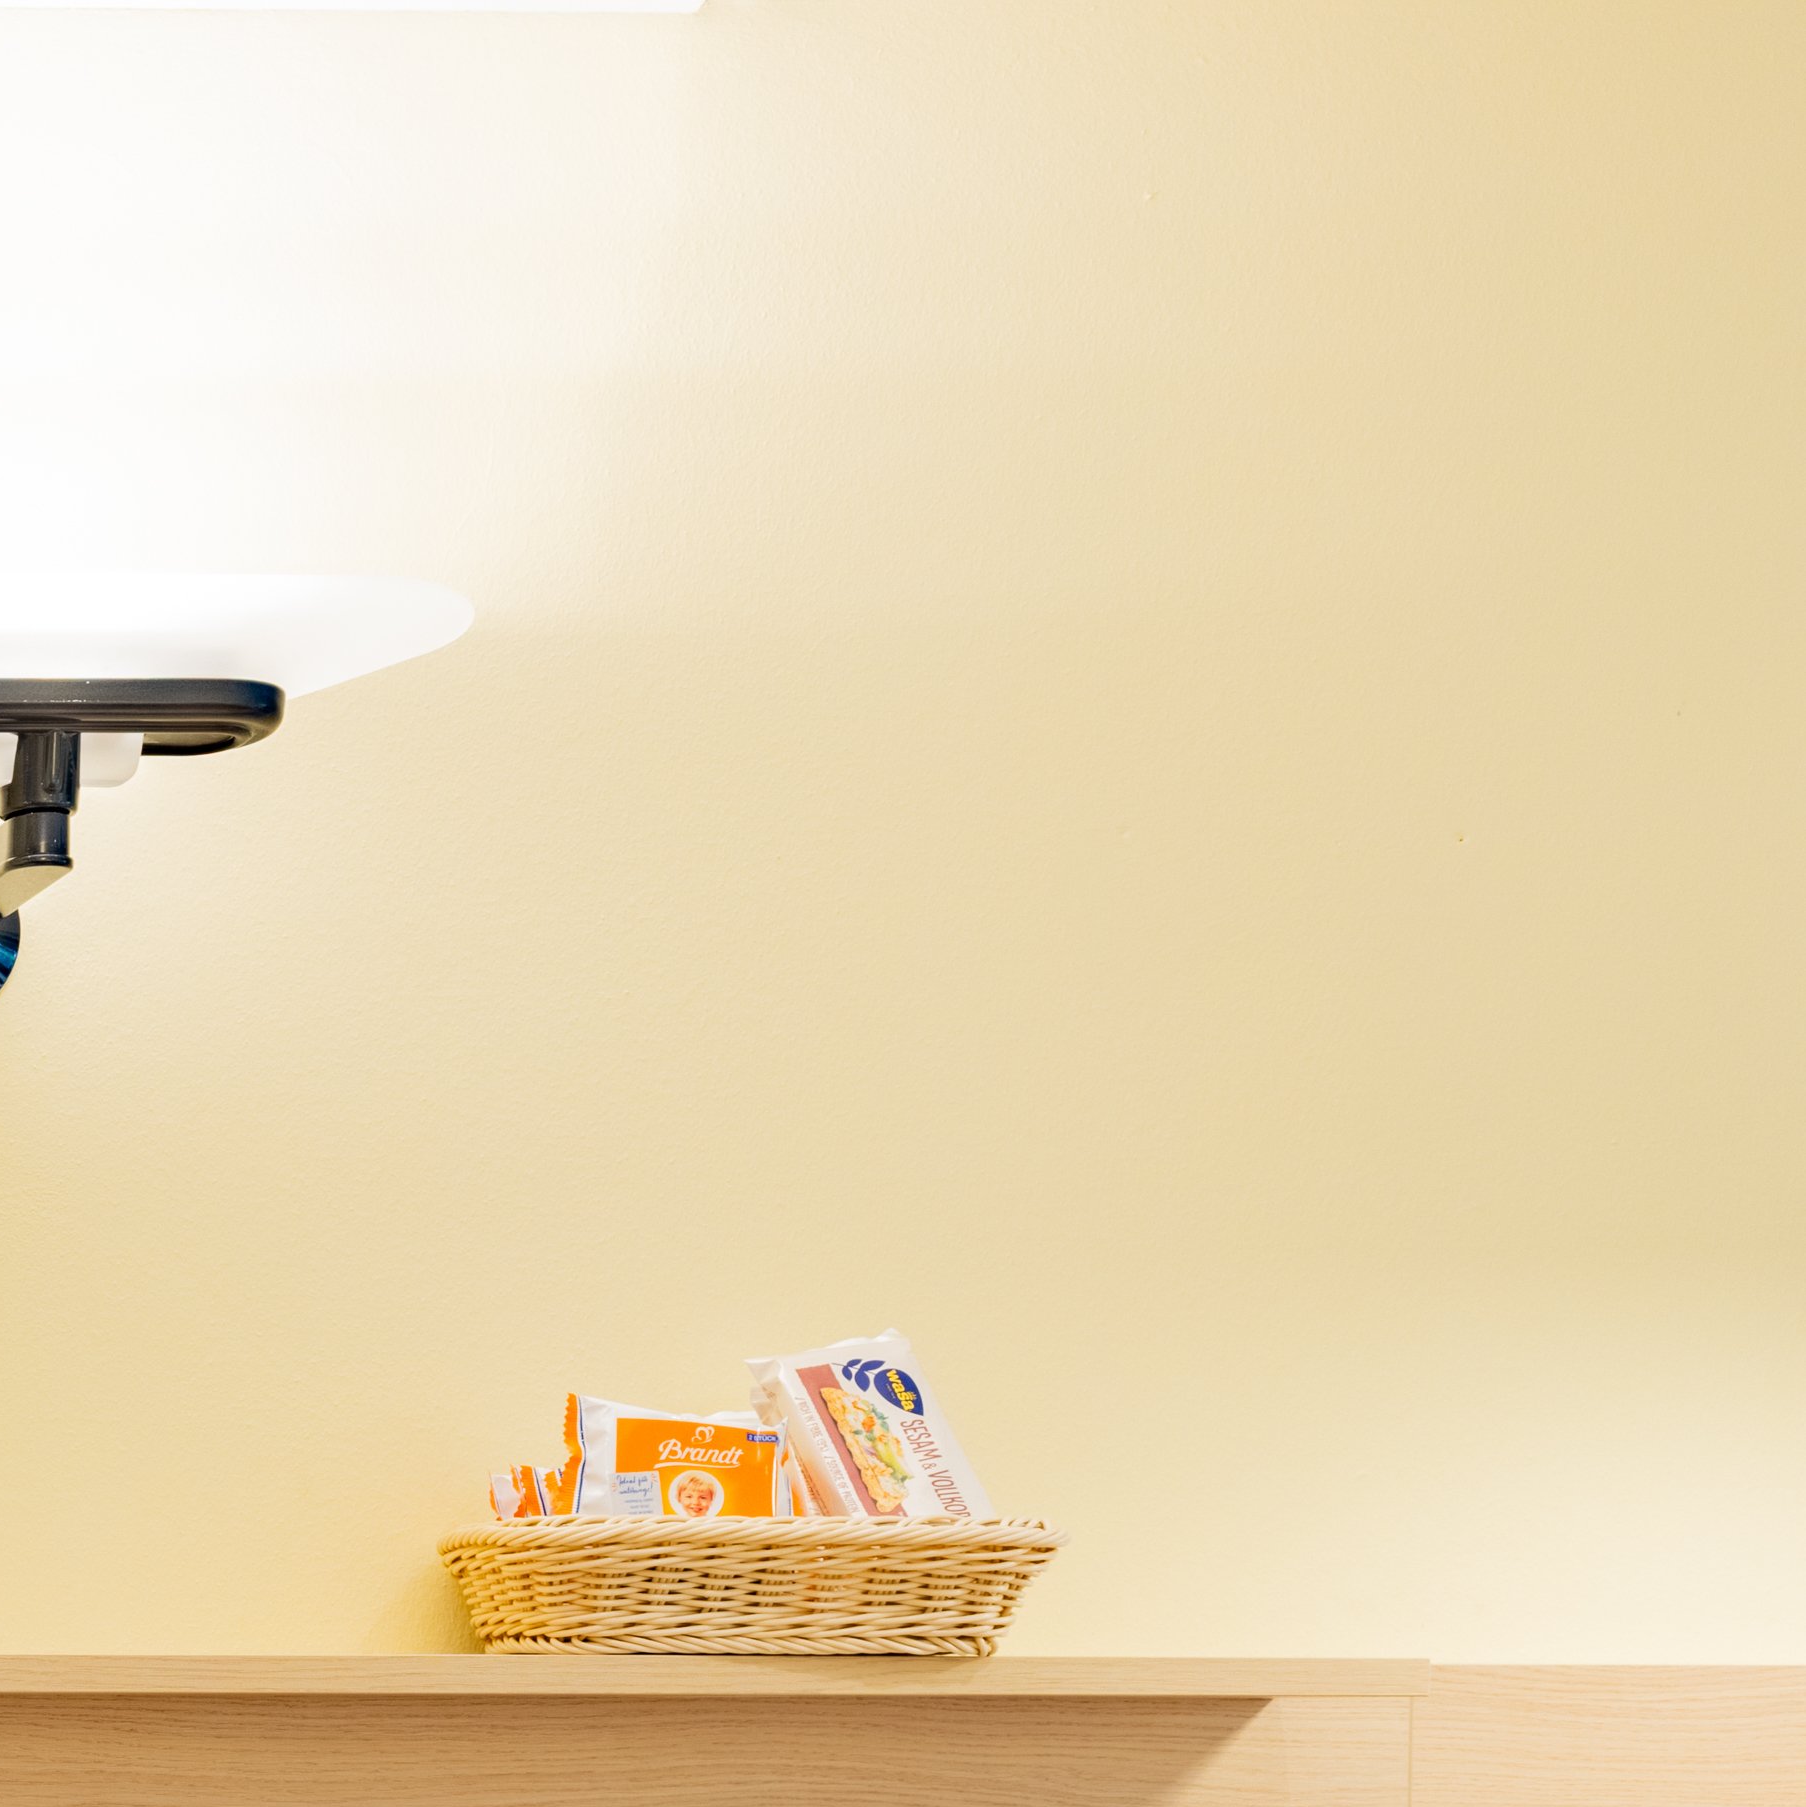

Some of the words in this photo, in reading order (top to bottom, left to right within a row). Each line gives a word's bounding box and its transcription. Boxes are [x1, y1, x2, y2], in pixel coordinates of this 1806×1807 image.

[886, 1369, 915, 1412] wasa
[658, 1438, 744, 1465] Brandt
[900, 1419, 942, 1463] SESAM
[921, 1462, 937, 1470] &
